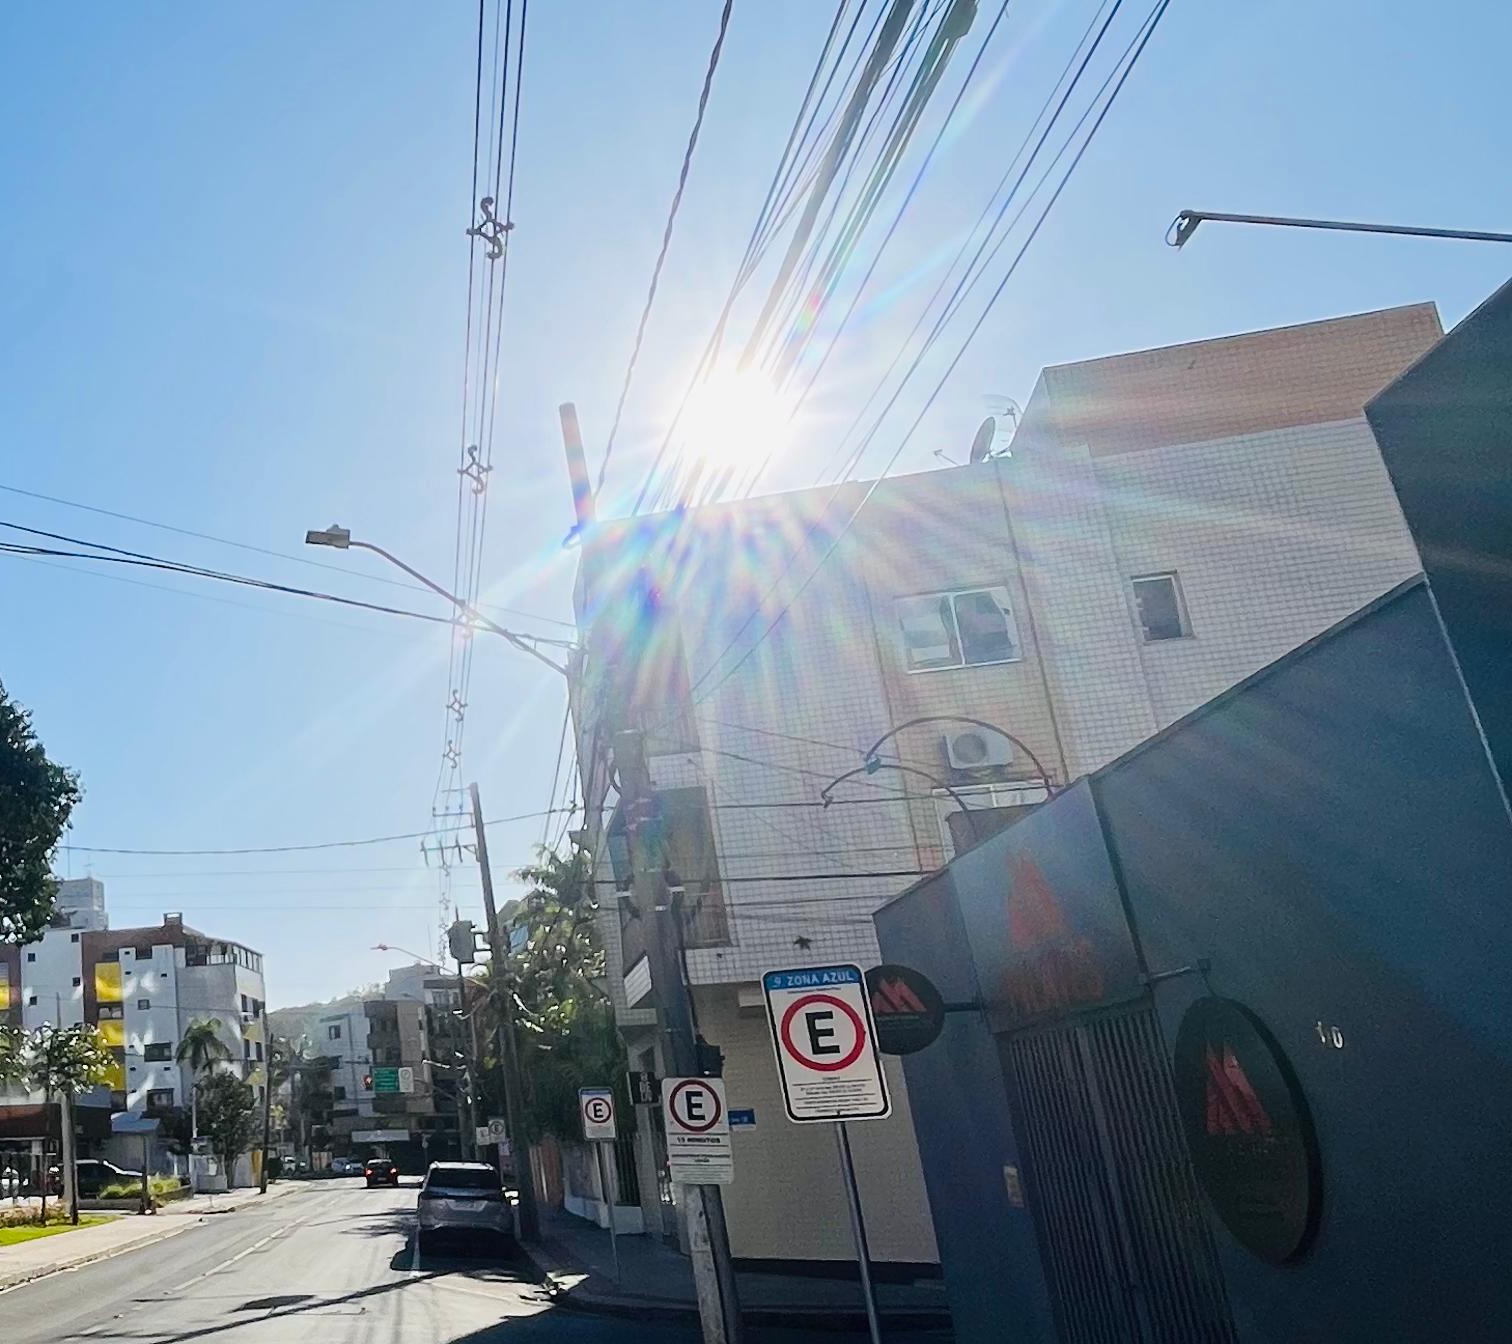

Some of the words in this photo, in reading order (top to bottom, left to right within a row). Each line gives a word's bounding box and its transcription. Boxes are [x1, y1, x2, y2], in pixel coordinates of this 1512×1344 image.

[787, 974, 820, 986] ZONA
[822, 970, 854, 983] AZUL
[805, 1011, 840, 1055] E
[593, 1103, 603, 1118] E
[685, 1091, 706, 1121] E
